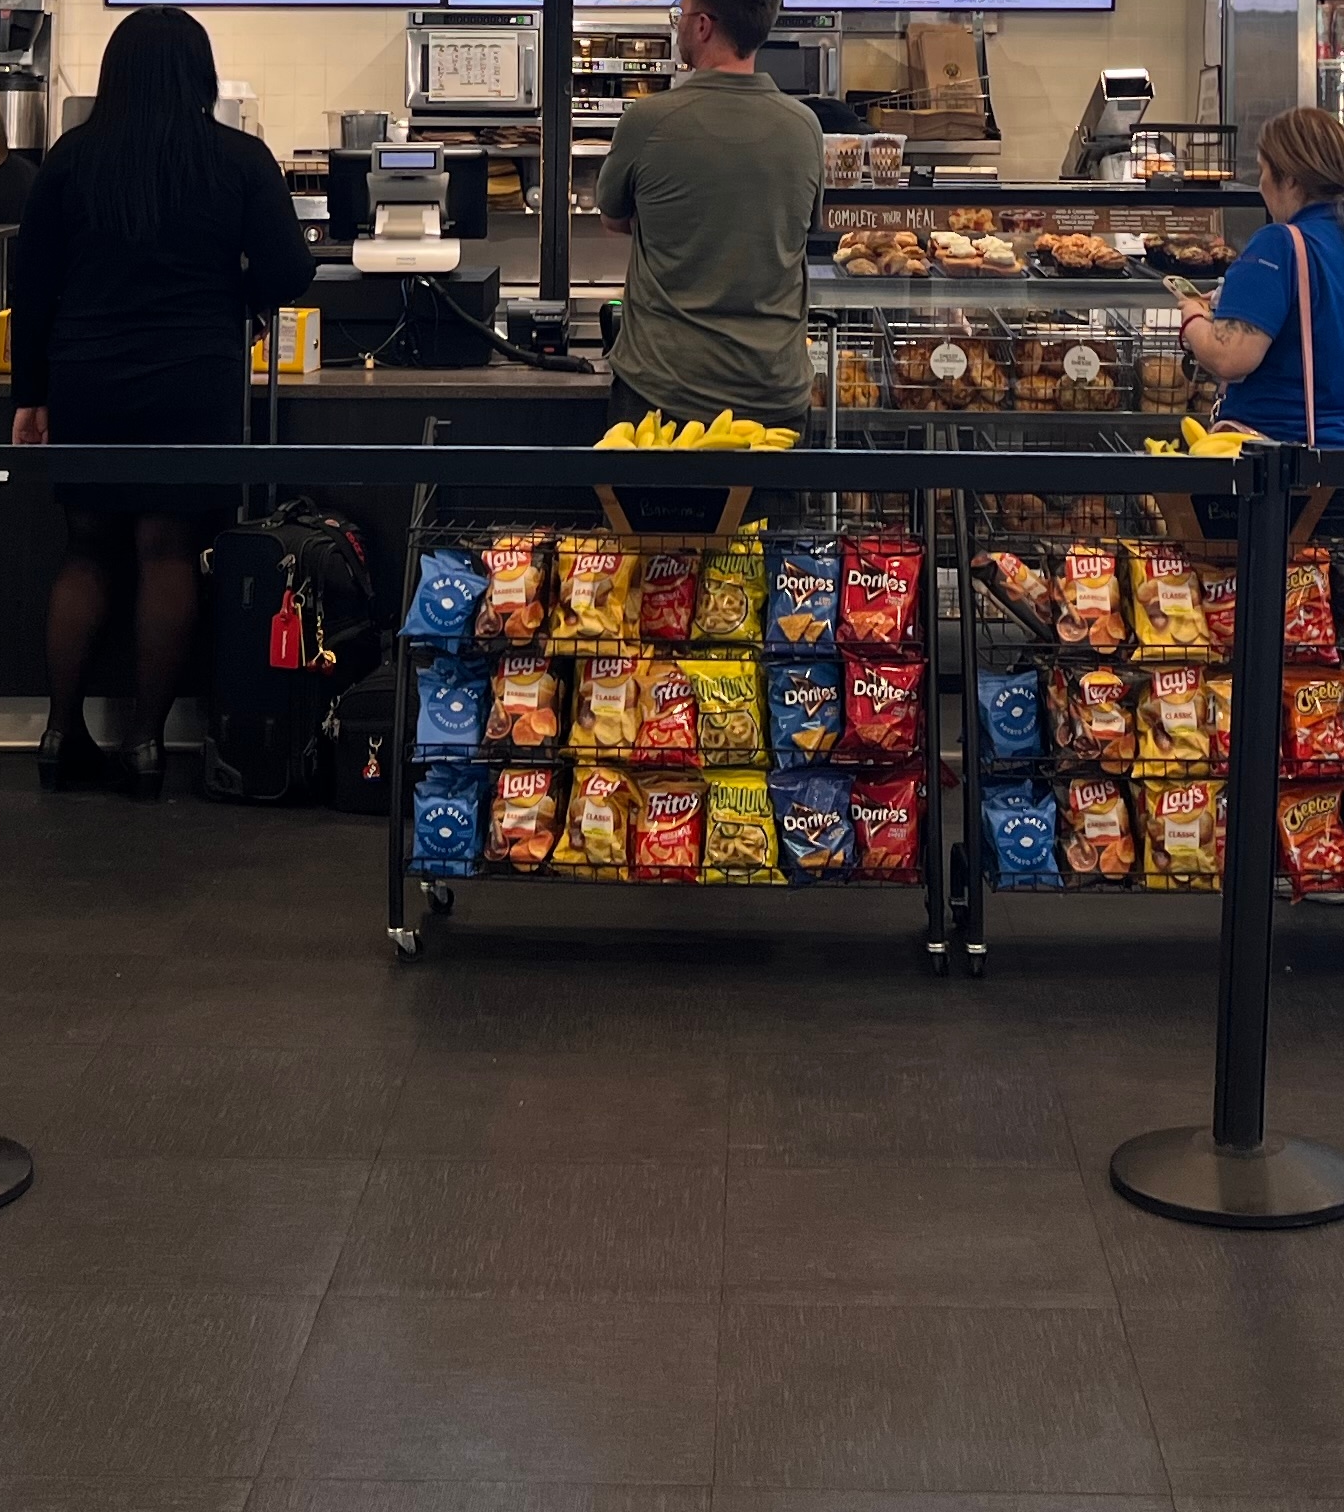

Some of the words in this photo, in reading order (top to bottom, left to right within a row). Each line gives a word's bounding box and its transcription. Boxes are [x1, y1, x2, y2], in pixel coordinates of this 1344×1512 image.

[827, 208, 878, 229] COMPLETE
[882, 211, 902, 225] YOUR
[573, 553, 616, 575] Lays
[1072, 554, 1112, 579] Lays
[432, 577, 451, 590] SEA
[453, 579, 473, 601] SALT
[776, 574, 834, 592] Doritos
[847, 569, 907, 593] Doritos
[504, 656, 545, 677] Lays
[591, 658, 633, 679] Lays
[1155, 667, 1196, 698] Lay's
[784, 685, 838, 706] Doritos
[995, 689, 1010, 708] SEA
[1012, 687, 1035, 701] SALT
[1165, 711, 1193, 720] CLASSIC
[503, 771, 546, 799] Lay's
[647, 791, 699, 822] Fritos
[1161, 785, 1204, 814] Lay's
[425, 807, 445, 823] SEA
[446, 806, 469, 827] SALT
[783, 811, 841, 832] Doritos
[851, 804, 908, 823] Doritos
[1284, 795, 1338, 833] Cheetos
[1003, 818, 1021, 834] SEA
[1023, 817, 1047, 832] SALT
